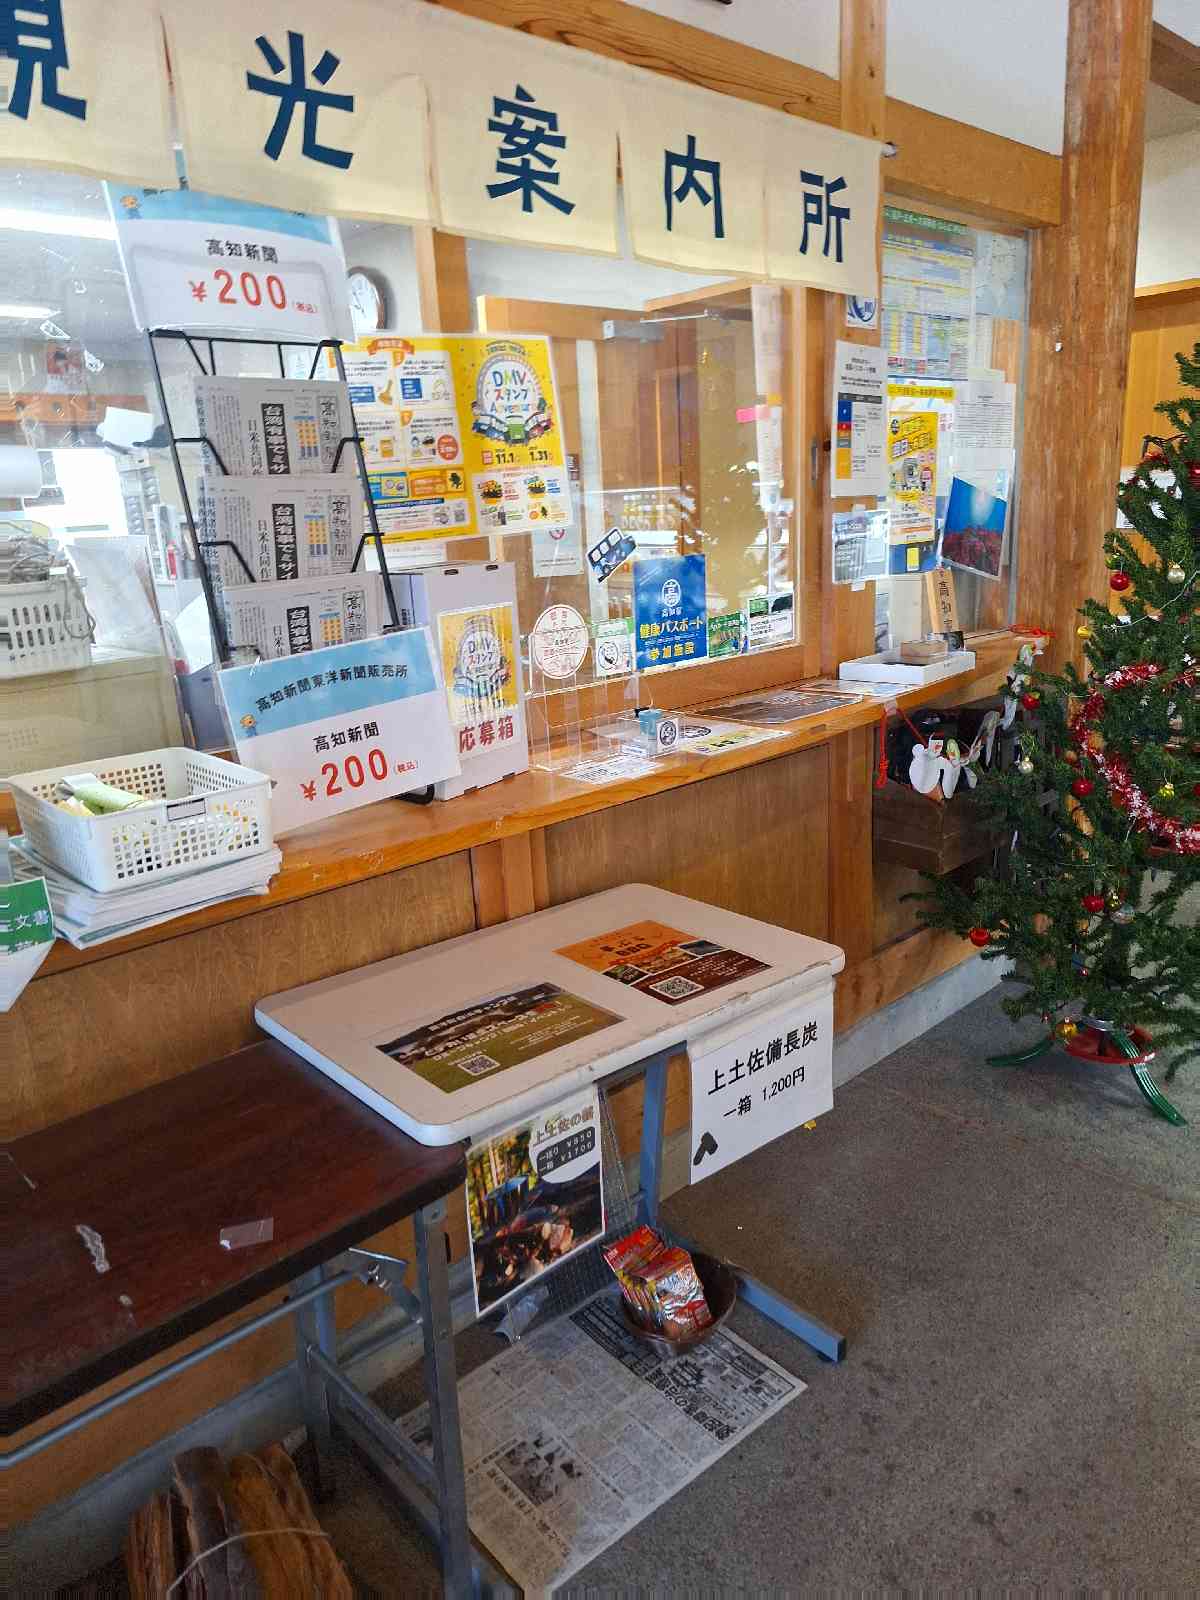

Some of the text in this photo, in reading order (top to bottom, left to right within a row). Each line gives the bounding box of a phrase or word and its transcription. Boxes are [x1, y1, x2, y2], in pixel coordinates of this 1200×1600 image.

[205, 238, 280, 263] 高知新聞
[492, 369, 528, 387] DMV
[255, 663, 409, 712] 高知新聞東洋新聞販売所
[312, 720, 380, 753] 高知新聞
[459, 715, 514, 753] 応募箱
[300, 748, 389, 801] ¥200
[707, 1020, 818, 1096] 上土佐備長炭
[723, 1066, 806, 1117] 一箱 1,200円
